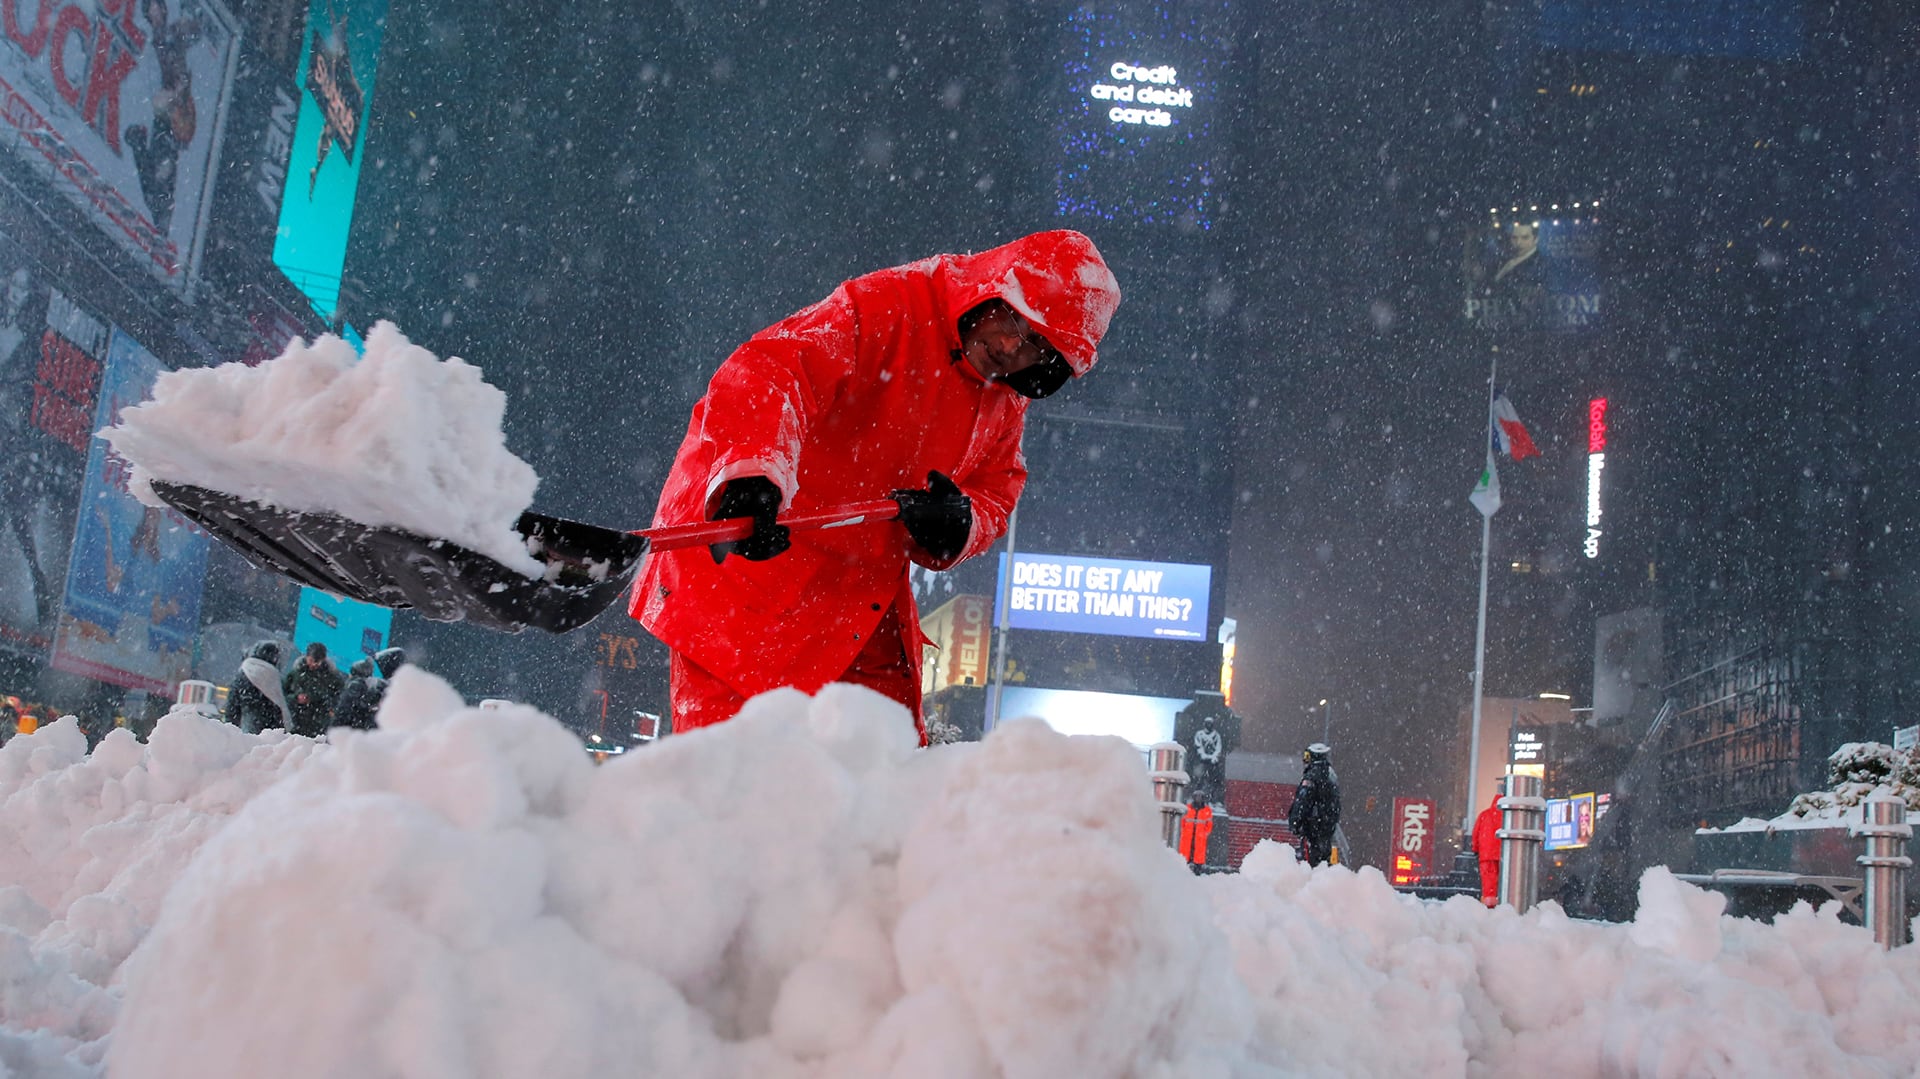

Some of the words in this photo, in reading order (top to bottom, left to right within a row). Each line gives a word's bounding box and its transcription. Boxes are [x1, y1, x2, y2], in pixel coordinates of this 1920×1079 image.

[1110, 62, 1177, 85] Credit
[1090, 84, 1134, 102] and
[1136, 86, 1193, 108] debit
[1109, 107, 1172, 127] cards
[256, 86, 297, 216] NEW
[1464, 293, 1601, 319] PHAOM
[1589, 398, 1608, 452] Kodak
[1584, 528, 1602, 558] App
[1013, 562, 1062, 588] DOES
[1065, 564, 1084, 588] IT
[1086, 566, 1121, 591] GET
[1123, 569, 1163, 594] ANY
[1011, 587, 1080, 614] BETTER
[1083, 591, 1134, 618] THAN
[1137, 595, 1192, 622] THIS?
[1402, 803, 1430, 851] tkts
